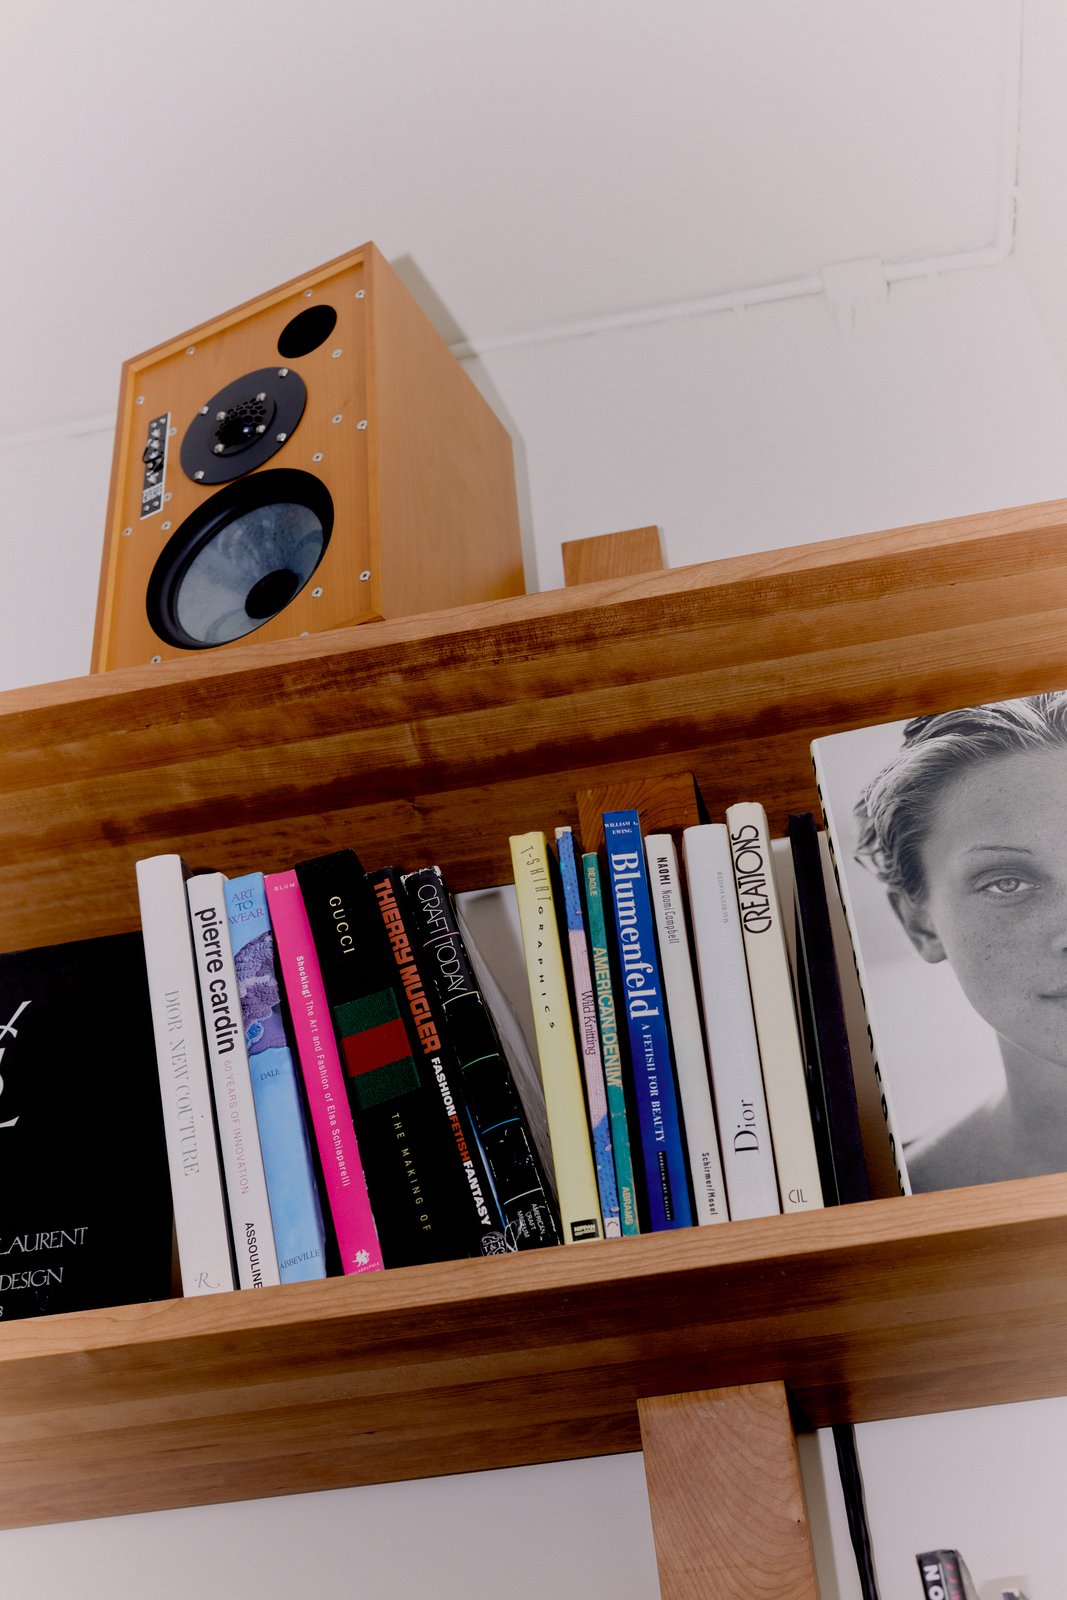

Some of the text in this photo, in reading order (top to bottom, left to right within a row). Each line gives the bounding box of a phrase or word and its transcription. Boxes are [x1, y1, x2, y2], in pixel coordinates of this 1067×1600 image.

[231, 888, 255, 902] ART
[274, 882, 296, 892] BLUM
[520, 845, 551, 901] T-SHIRT
[587, 867, 598, 896] BEAGLE
[657, 856, 671, 885] NAOMI
[731, 825, 772, 934] CREATIONS
[228, 908, 264, 925] WEAR
[235, 900, 253, 912] TO
[329, 896, 355, 953] GUCCI
[417, 884, 468, 992] CRAFT TODAY
[611, 851, 660, 1020] Blumenfeld
[194, 907, 238, 1055] pierre cardin
[373, 878, 442, 1054] THIERRY MUGLER
[537, 906, 556, 1029] GRAPHICS
[581, 990, 597, 1055] Wild Knitting
[592, 947, 623, 1088] AMERICAN DENIM
[260, 1068, 280, 1081] DALE
[296, 955, 351, 1187] Shocking! The Art and Fashion of Elsa Schiaparelli
[643, 1034, 656, 1071] FETISH
[164, 990, 200, 1176] DIOR NEW COUTURE
[648, 1075, 659, 1096] FOR
[223, 1060, 250, 1195] 60 YEARS OF INNOVATION
[651, 1101, 665, 1142] BEAUTY
[733, 1099, 760, 1155] Dior
[391, 1112, 432, 1231] THE MAKING OF
[702, 1152, 718, 1216] Schirmer/Mosel
[622, 1186, 634, 1225] ABRAMS
[0, 1267, 64, 1291] DESIGN
[245, 1222, 264, 1289] ASSOULINE
[280, 1249, 321, 1271] ABBEVILLE
